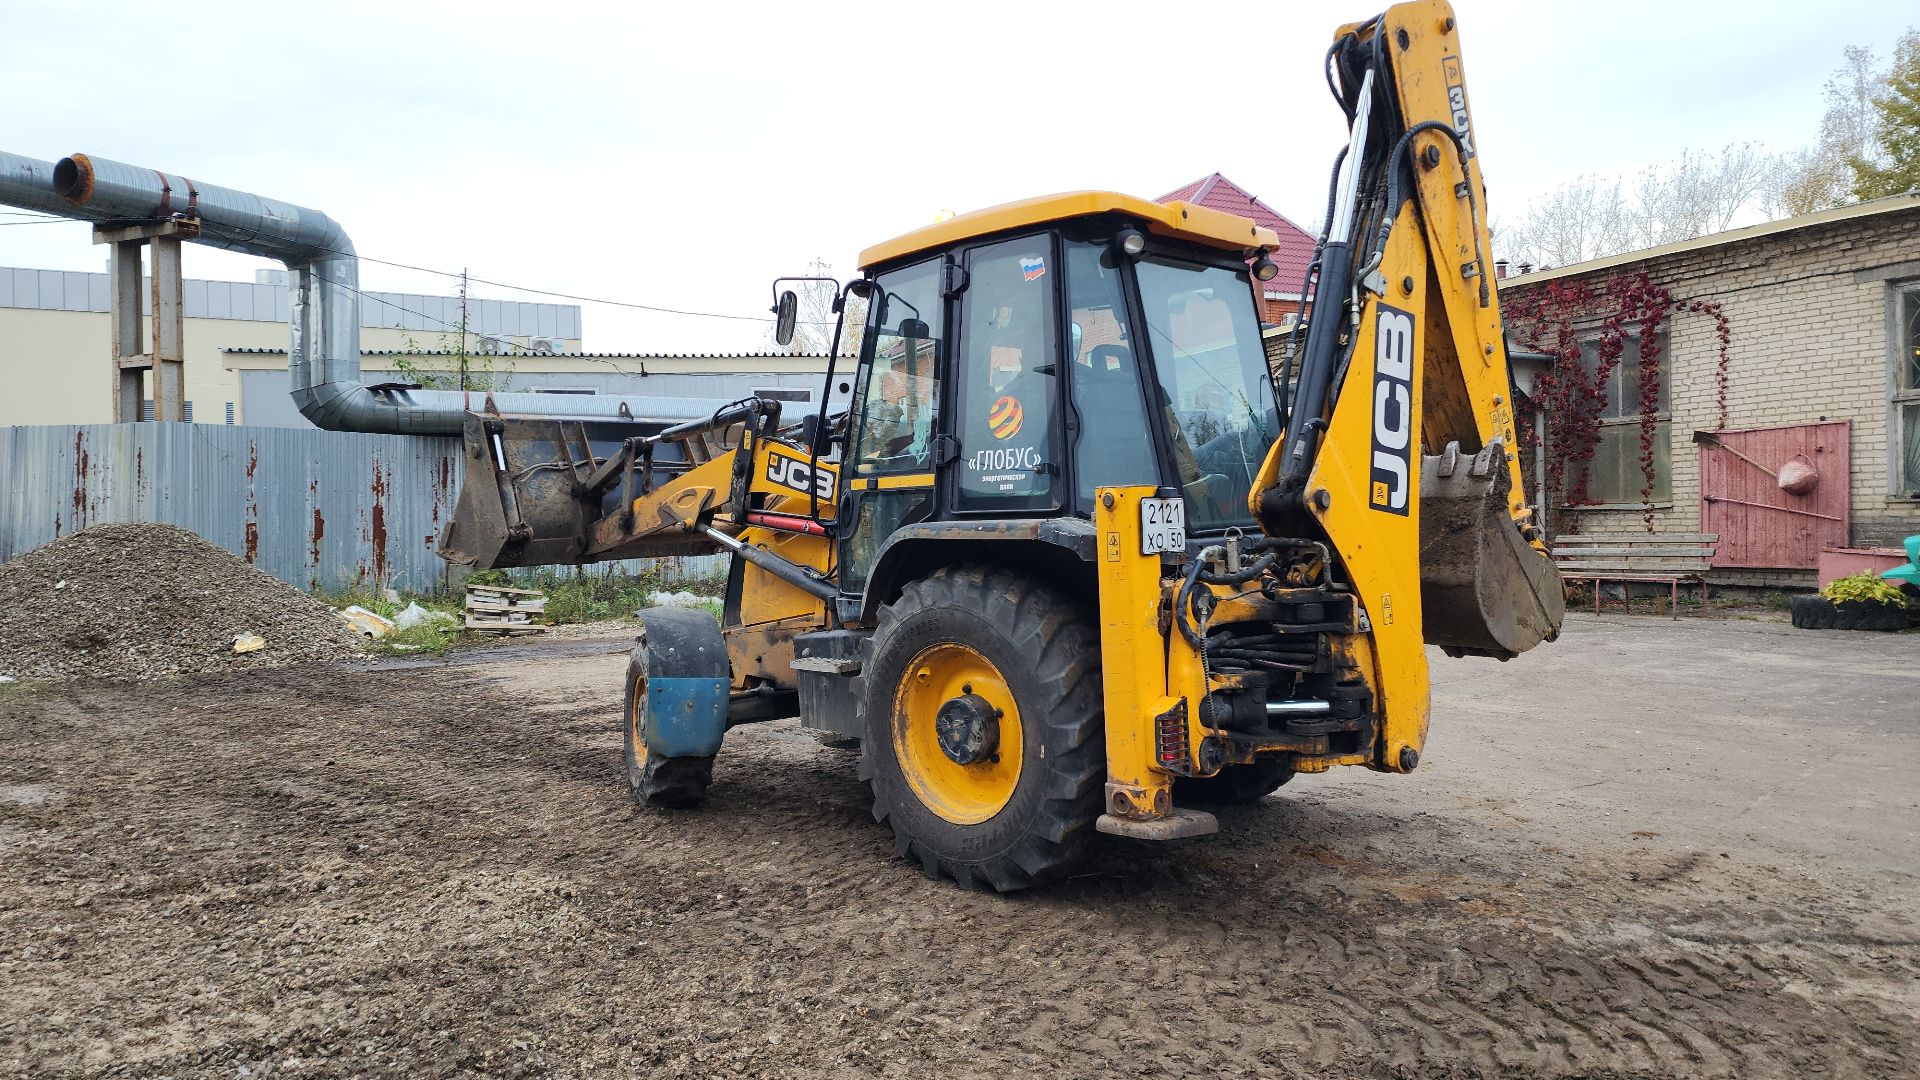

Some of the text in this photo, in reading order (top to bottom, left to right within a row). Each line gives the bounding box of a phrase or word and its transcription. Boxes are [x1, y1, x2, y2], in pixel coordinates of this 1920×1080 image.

[1449, 86, 1474, 153] 3CX
[1373, 311, 1412, 508] JCB
[968, 447, 1042, 471] «ГЛОБУС»
[768, 457, 834, 498] JCB
[981, 473, 1026, 483] энергетическая
[1148, 502, 1180, 524] 2121
[1171, 532, 1183, 548] 50
